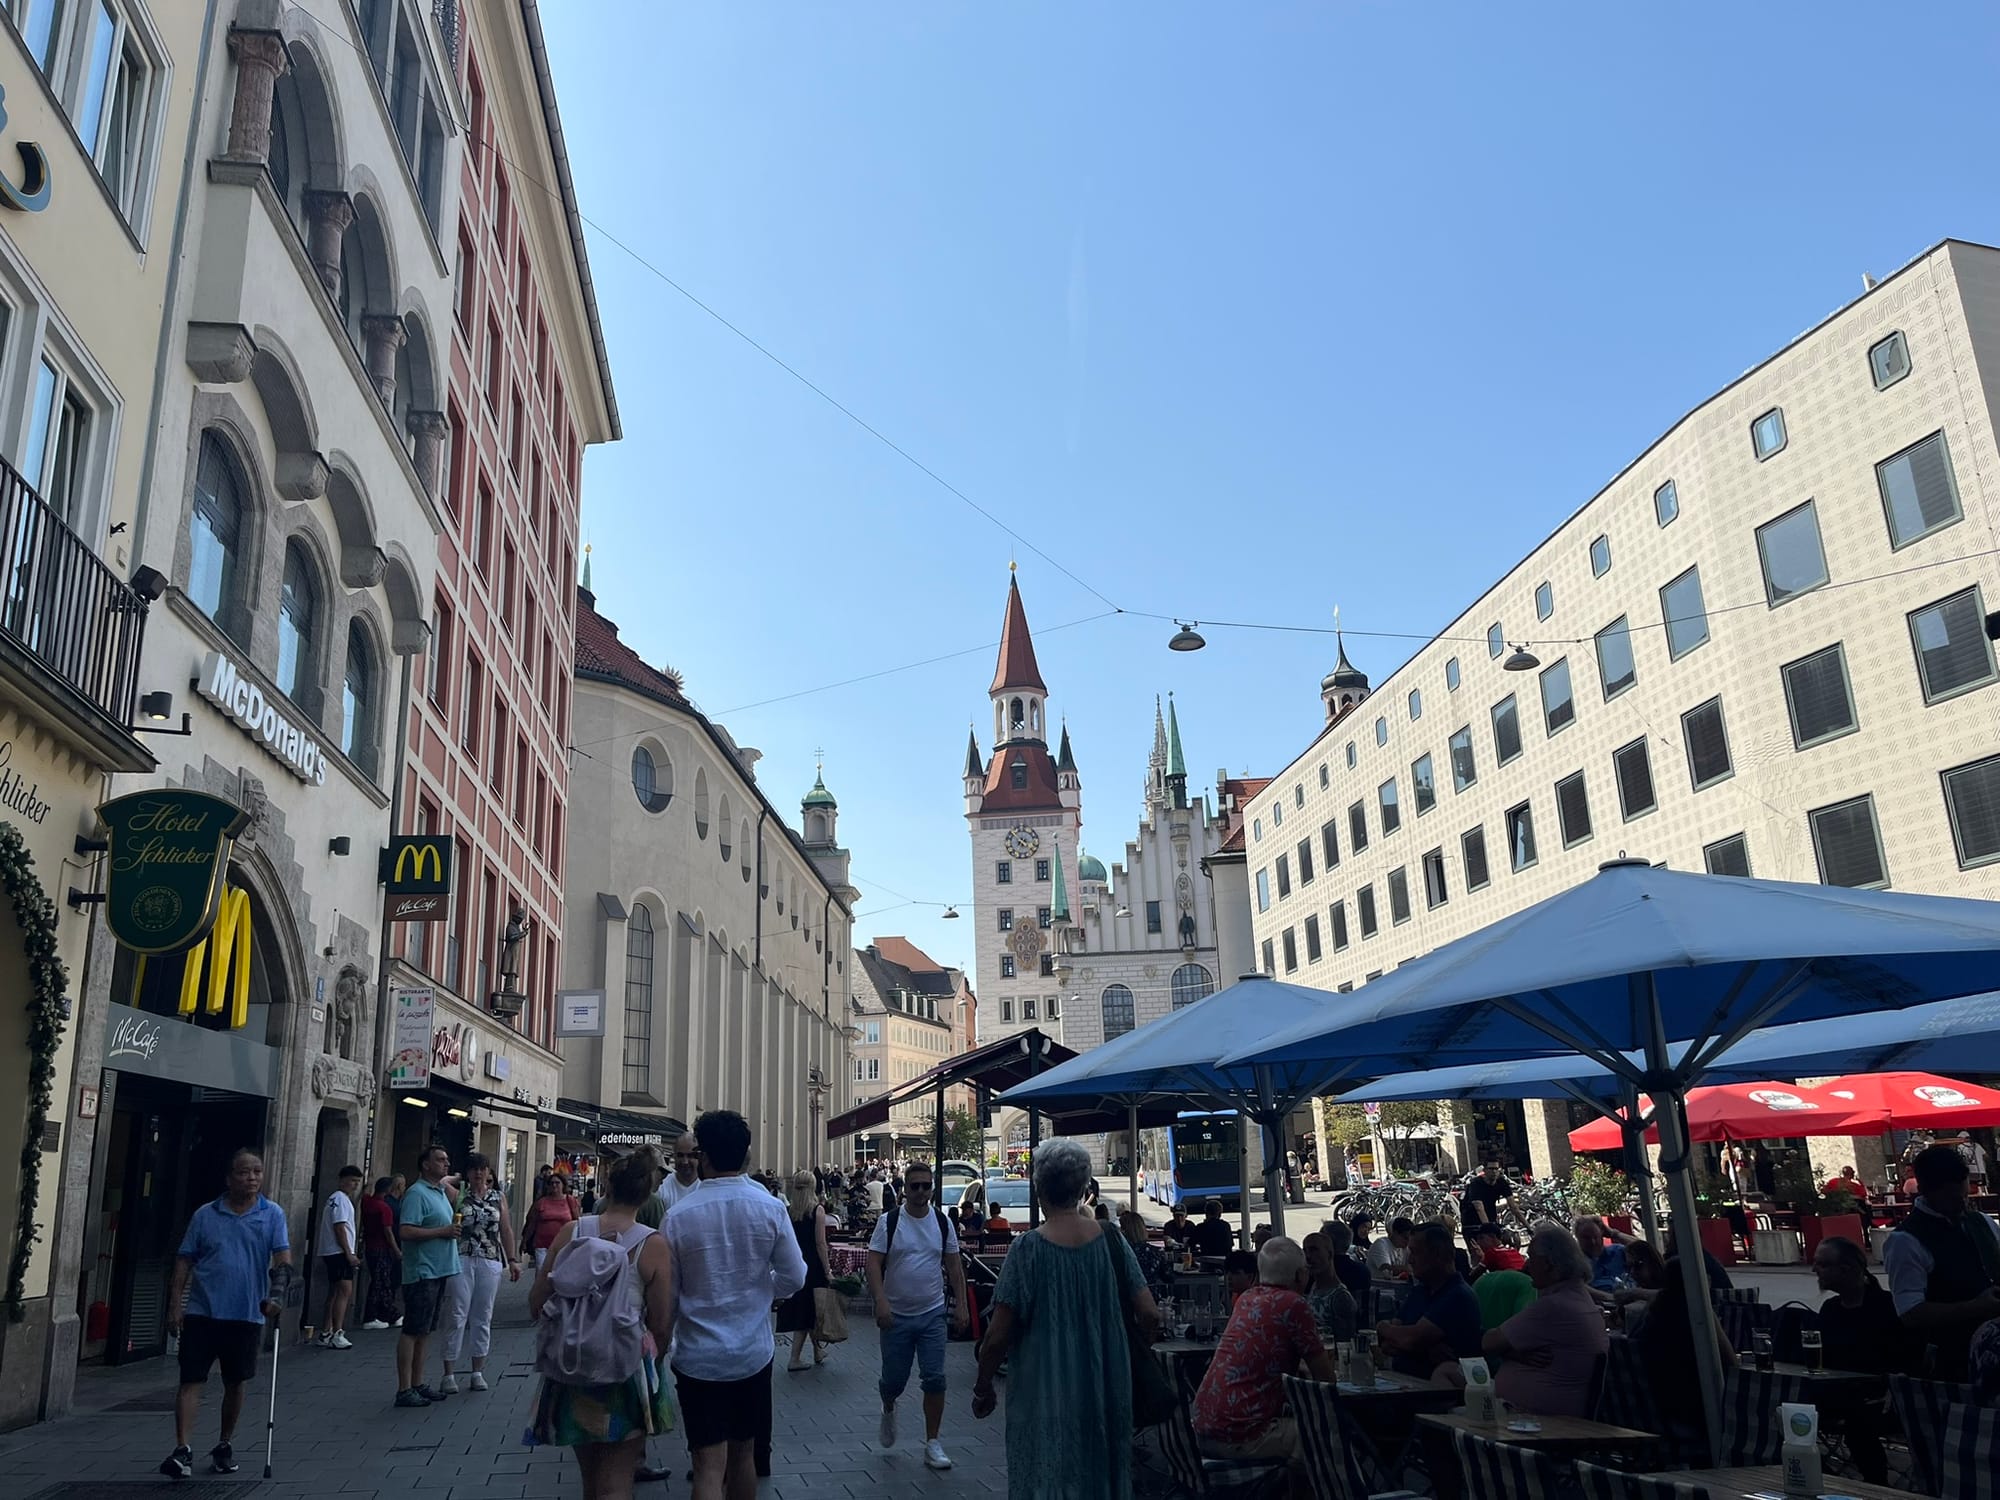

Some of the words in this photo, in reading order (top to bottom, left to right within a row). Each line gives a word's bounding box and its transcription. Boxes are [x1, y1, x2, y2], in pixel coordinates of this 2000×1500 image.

[211, 653, 327, 786] McDonald's
[128, 800, 206, 834] Hotel
[111, 836, 214, 872] Schlicker
[110, 1016, 160, 1060] McCafé
[598, 1132, 643, 1145] ederhosen
